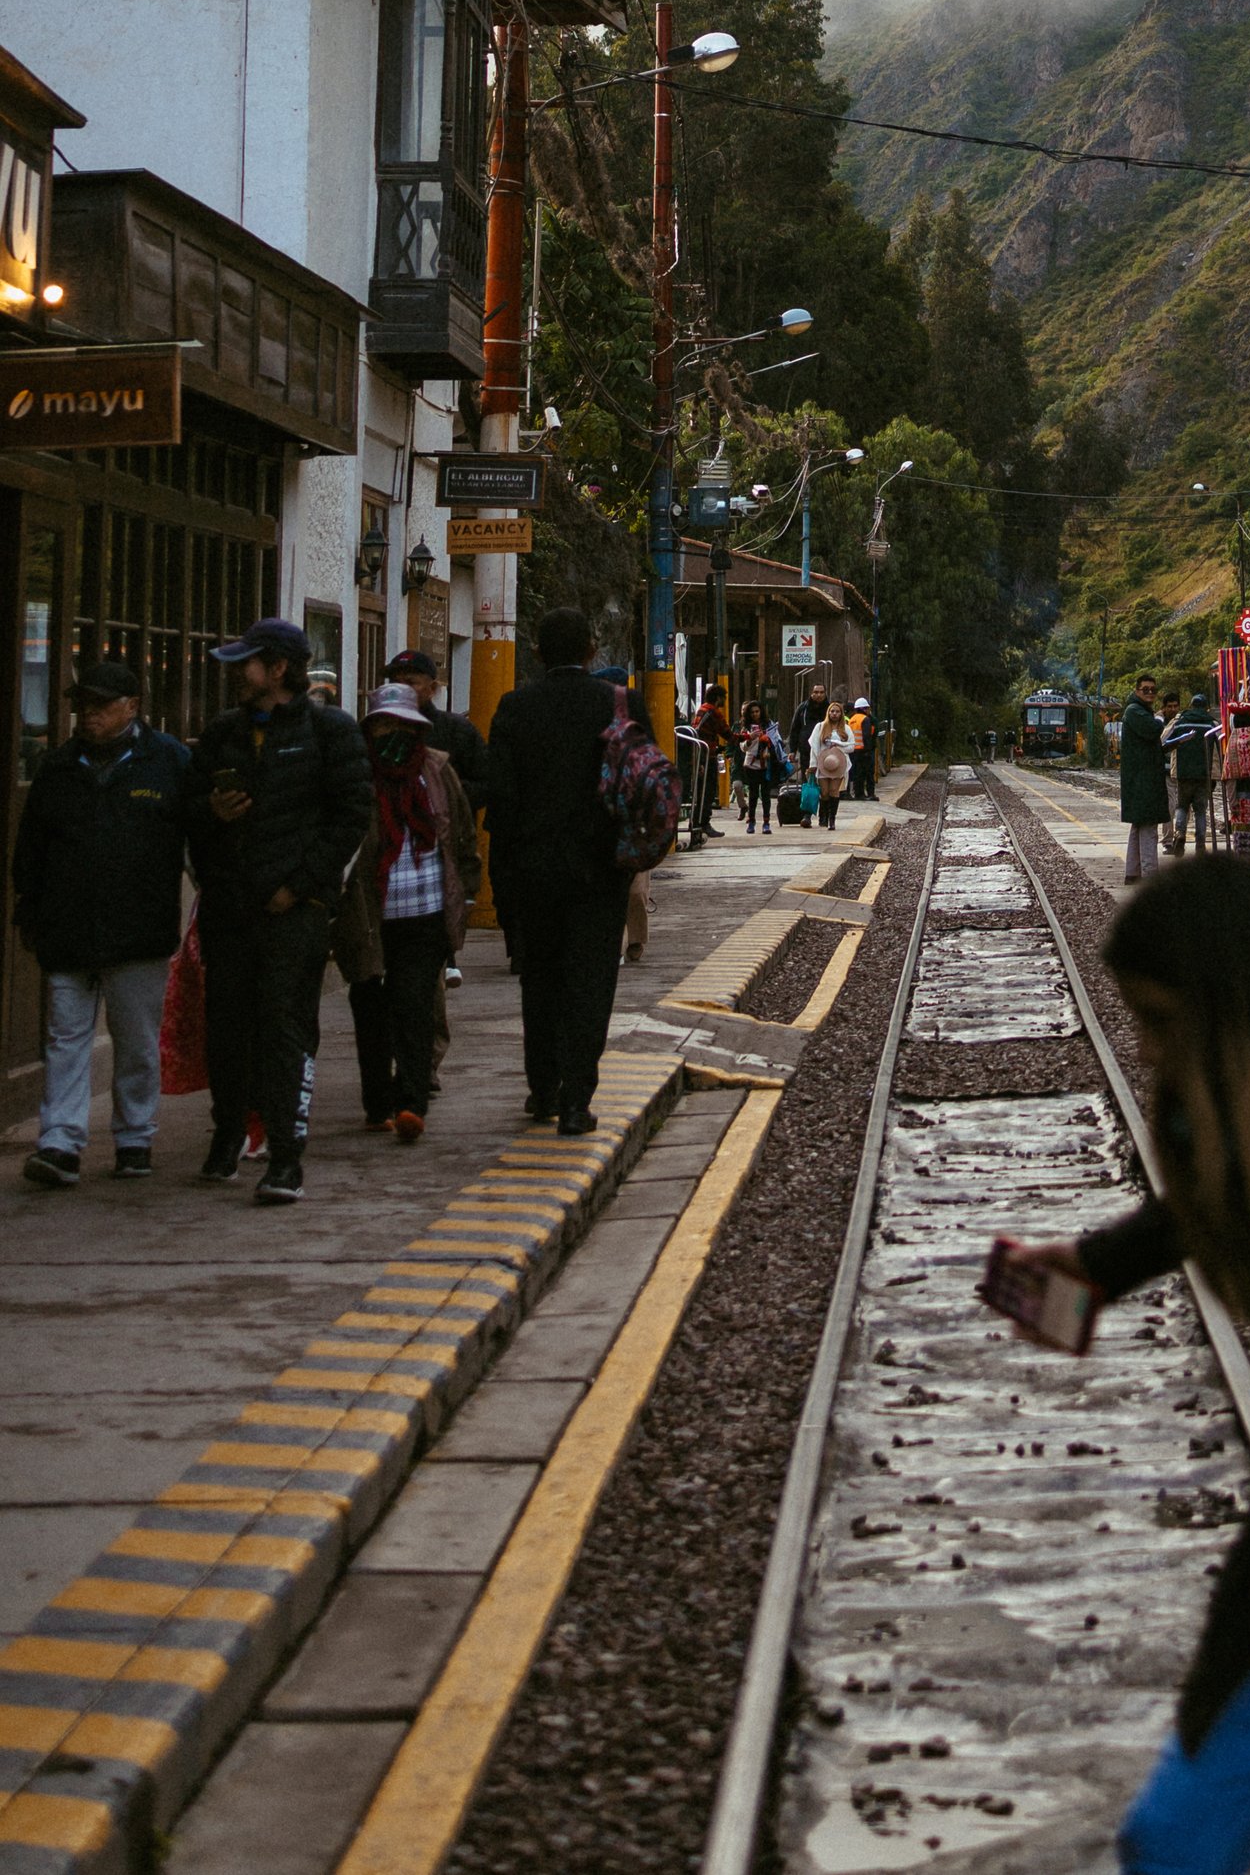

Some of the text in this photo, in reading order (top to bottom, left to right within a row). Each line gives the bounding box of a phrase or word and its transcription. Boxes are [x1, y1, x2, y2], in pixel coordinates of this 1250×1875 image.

[42, 387, 145, 417] mayu
[451, 472, 525, 482] EL ALBERGUE
[451, 523, 527, 536] VACANCY
